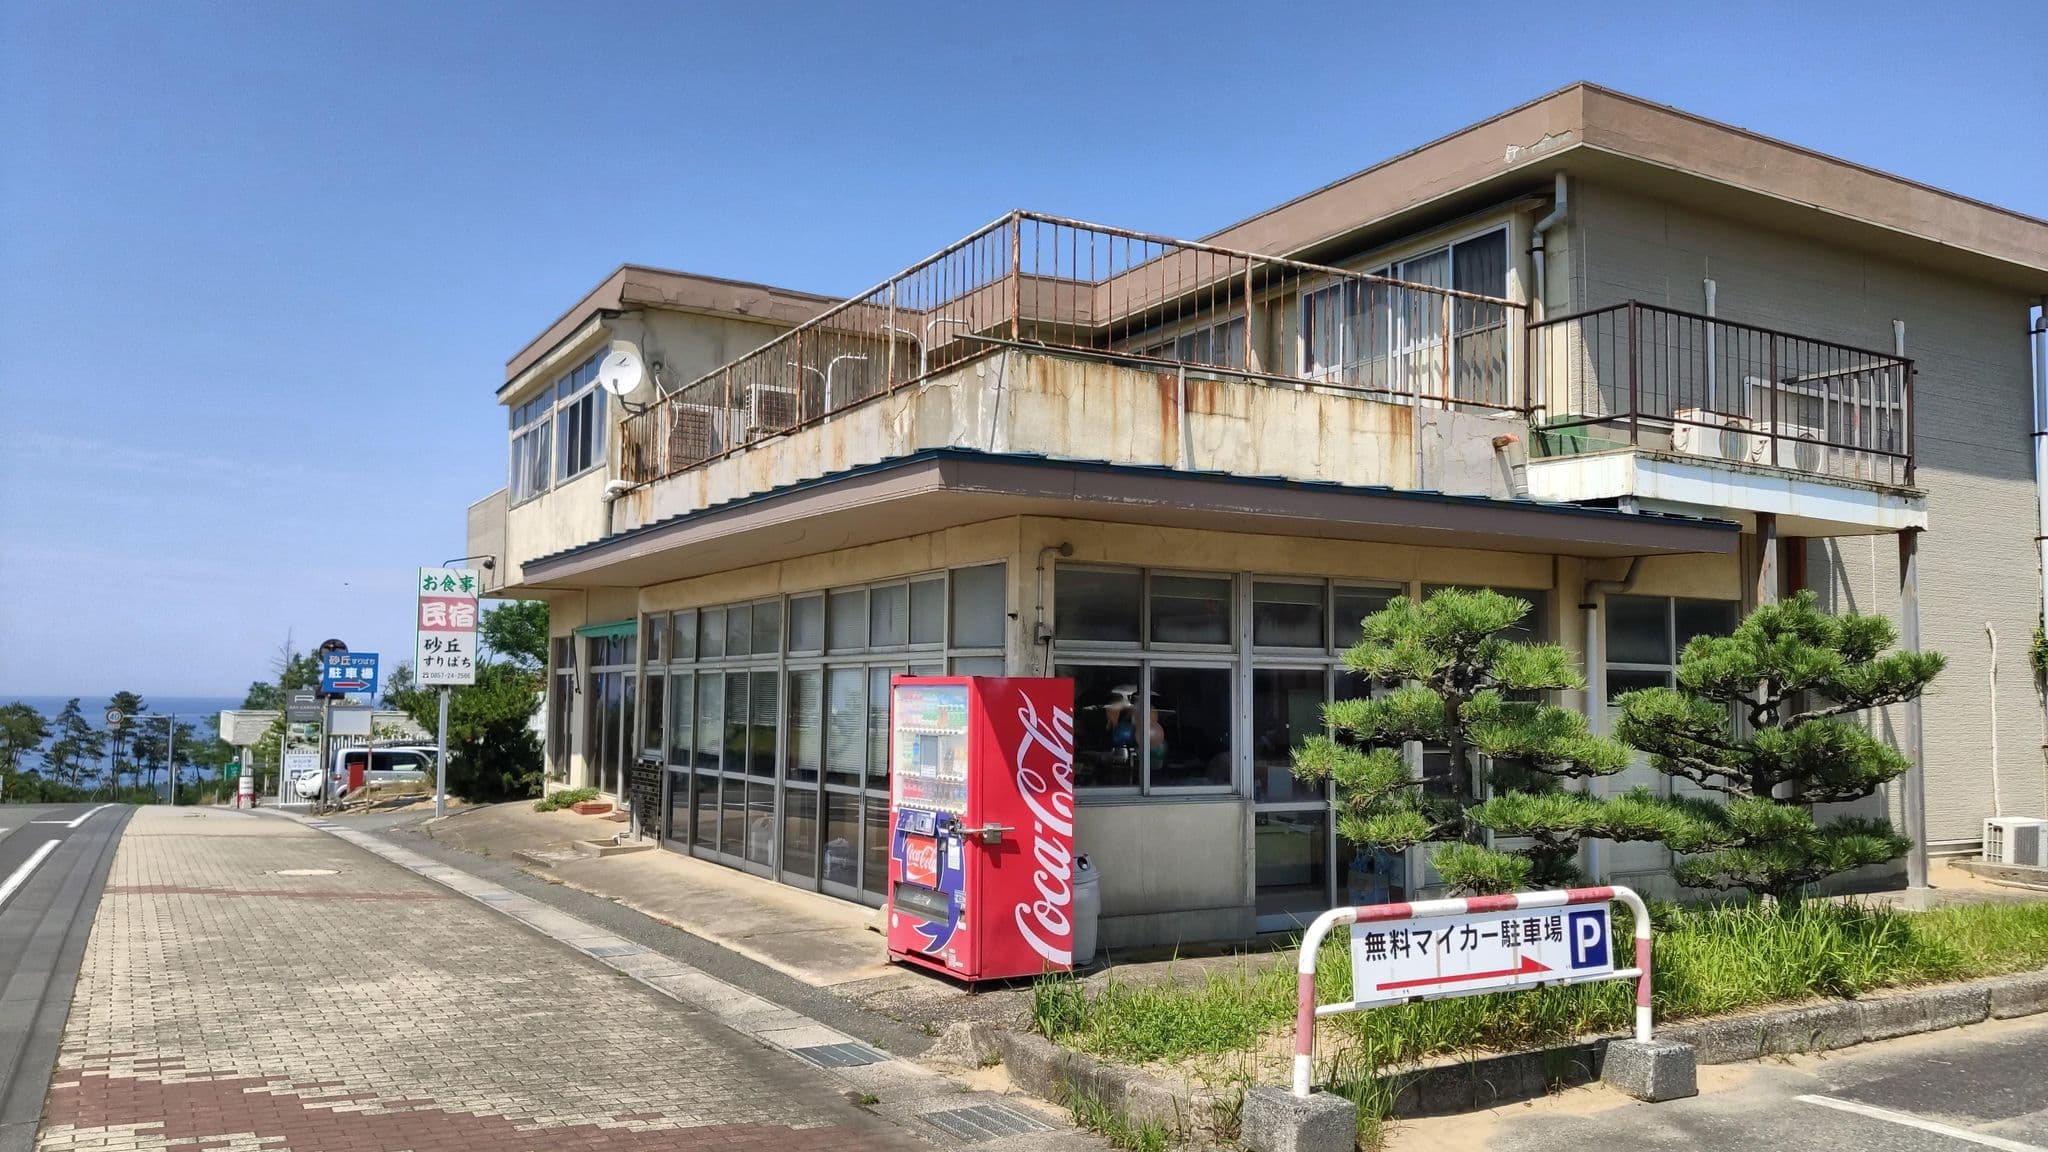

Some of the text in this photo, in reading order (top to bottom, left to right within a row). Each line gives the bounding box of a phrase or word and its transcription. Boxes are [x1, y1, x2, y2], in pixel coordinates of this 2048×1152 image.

[422, 574, 475, 593] お食事
[422, 601, 475, 628] 民宿
[423, 636, 461, 654] 砂丘
[423, 656, 471, 668] すりばち
[328, 667, 374, 679] 駐車場
[1014, 688, 1073, 965] Coca-Cola
[1364, 915, 1601, 963] 無料マイカー駐車場 P
